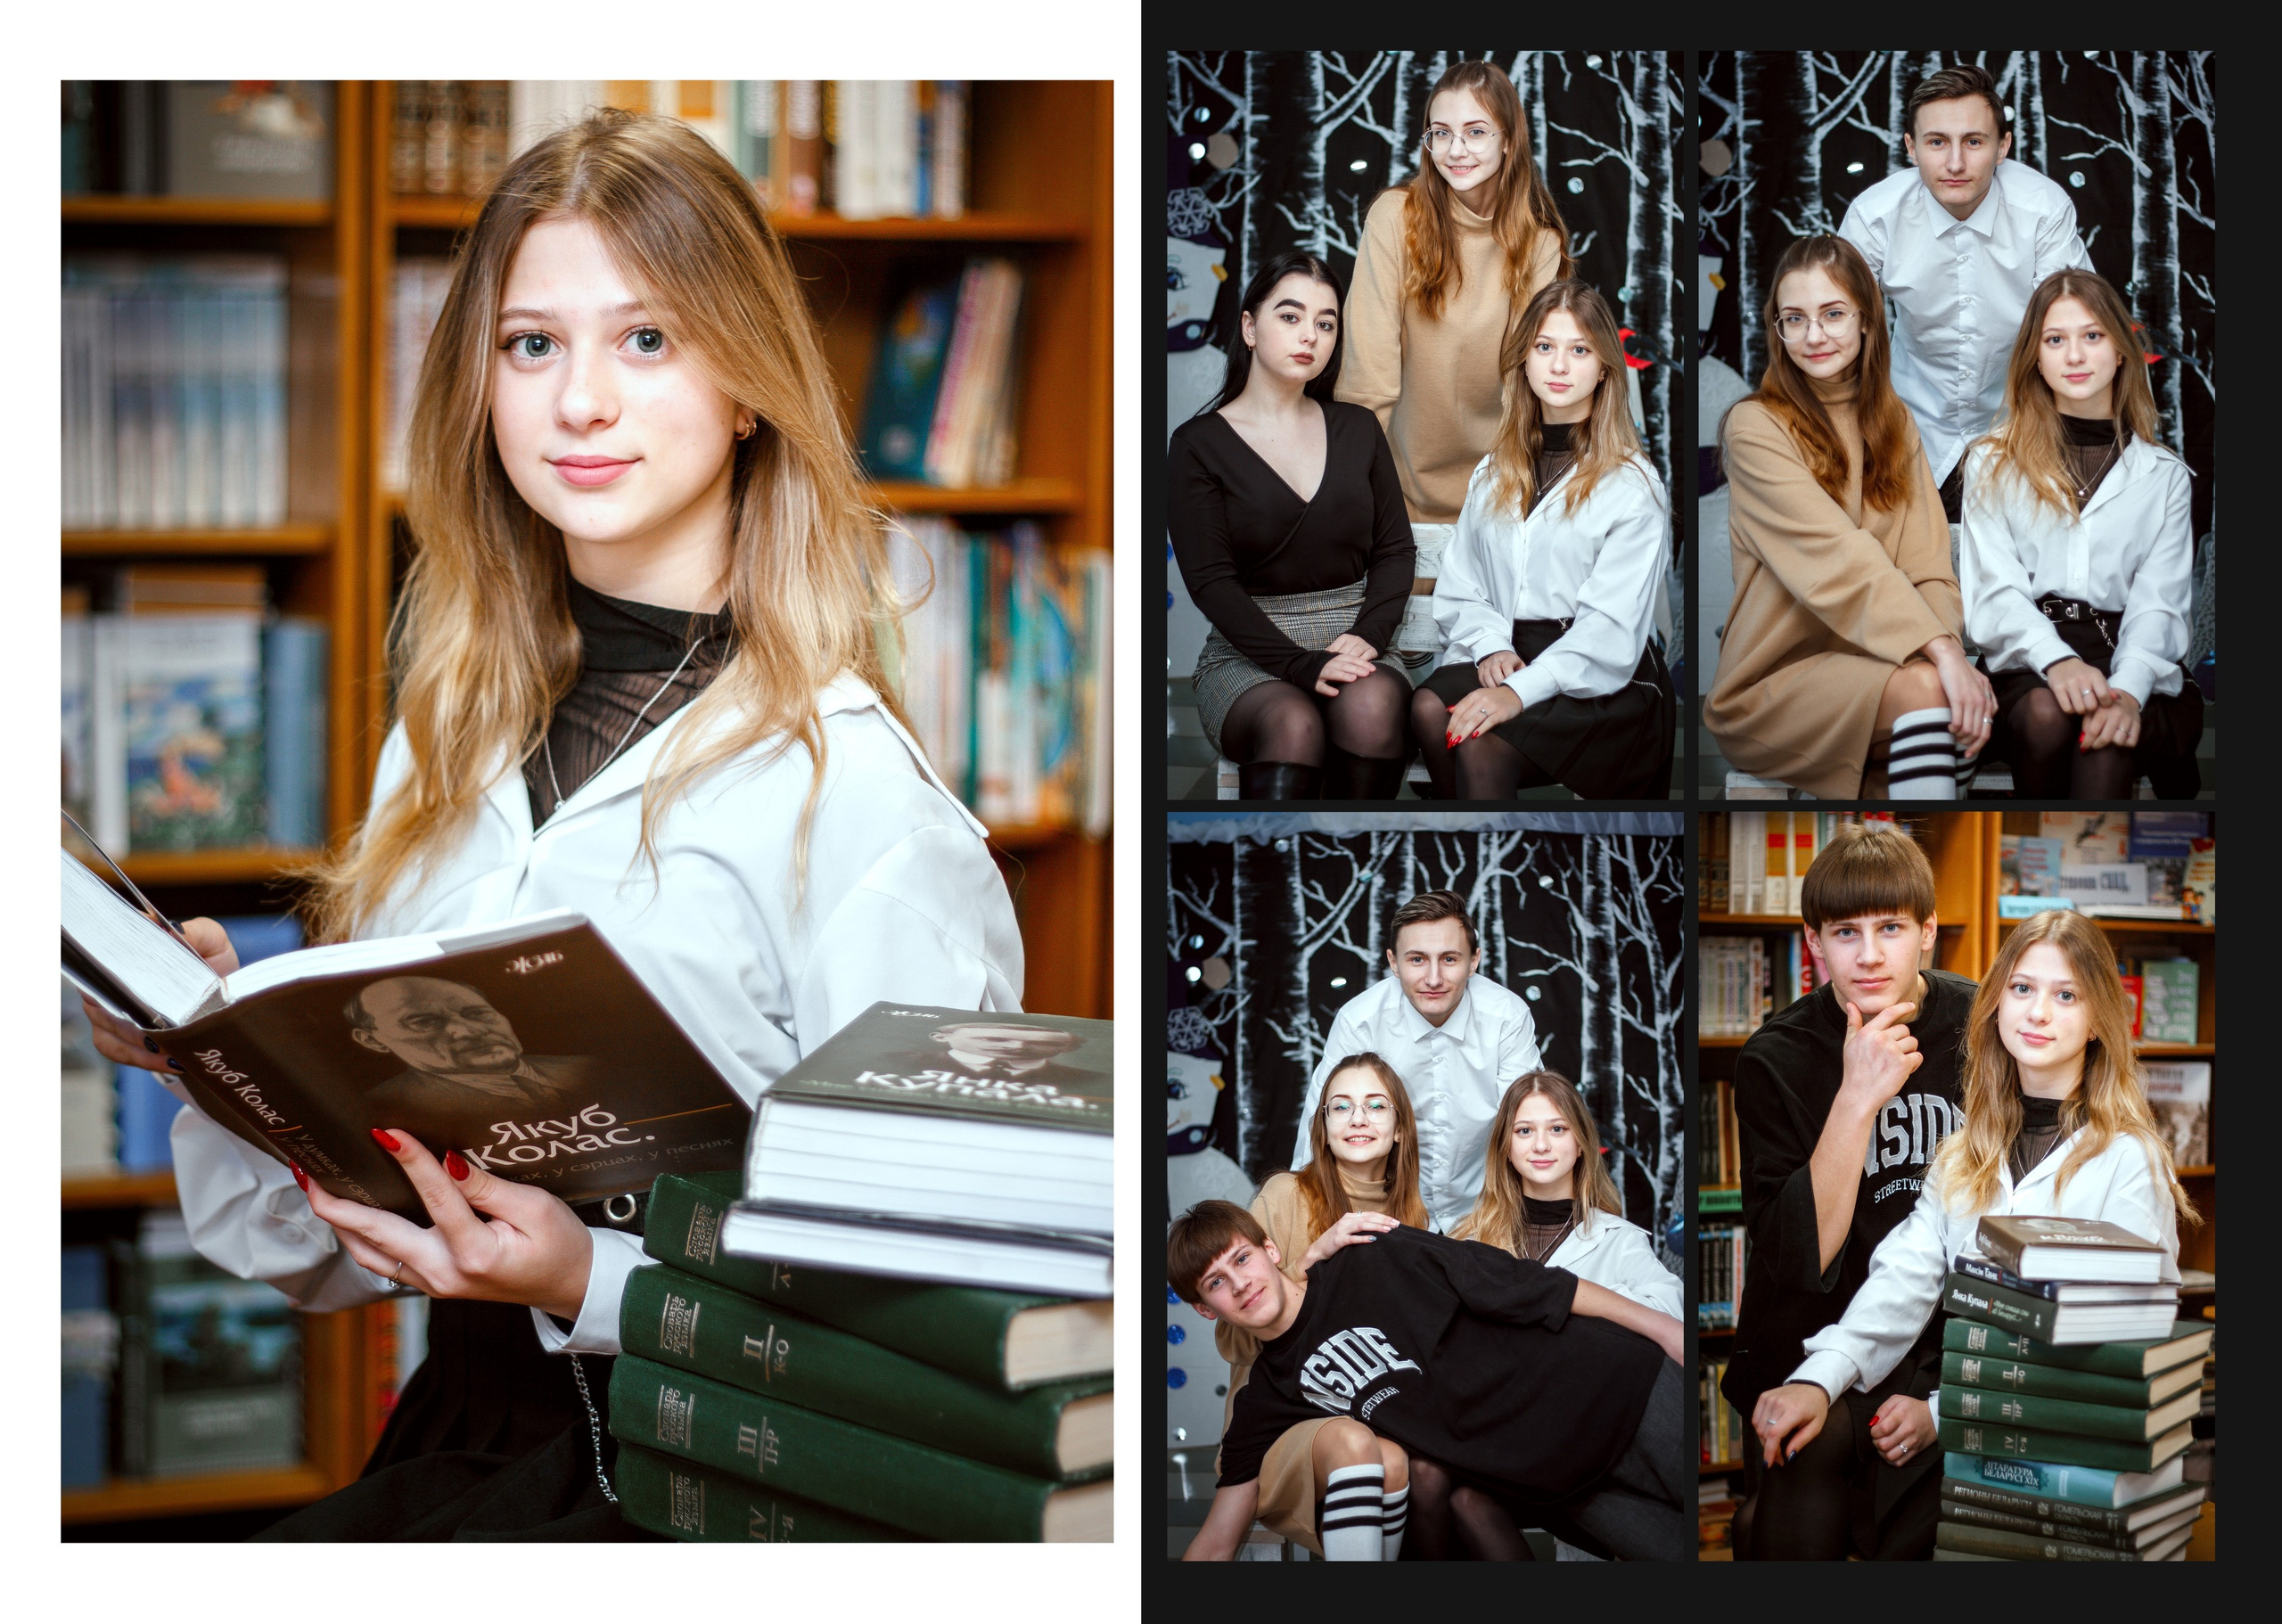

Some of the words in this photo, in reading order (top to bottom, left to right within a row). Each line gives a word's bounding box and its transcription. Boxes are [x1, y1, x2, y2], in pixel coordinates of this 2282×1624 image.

[193, 1049, 250, 1084] Якуб
[234, 1083, 285, 1126] Колас
[907, 1070, 1059, 1096] Янка
[489, 1103, 617, 1145] Якуб
[463, 1127, 656, 1171] Колас.
[666, 1137, 734, 1155] песнях
[688, 1205, 706, 1258] Словарь
[696, 1207, 712, 1262] русского
[702, 1218, 716, 1256] языка
[1984, 1267, 1999, 1282] Танк
[1952, 1289, 1966, 1302] Янка
[1967, 1292, 1989, 1308] Купала
[663, 1296, 679, 1349] Словарь
[673, 1298, 686, 1355] русского
[681, 1308, 693, 1349] языка
[660, 1388, 674, 1442] Словарь
[670, 1390, 681, 1446] русского
[677, 1401, 686, 1441] языка
[738, 1422, 758, 1457] III
[765, 1429, 780, 1465] П-Р
[1984, 1460, 2033, 1477] ЛІТАРАТУРА
[1984, 1468, 2023, 1483] БЕЛАРУСІ
[1954, 1486, 1991, 1501] РЕГИОНЫ
[1992, 1494, 2032, 1508] БЕЛАРУСИ
[2055, 1504, 2103, 1520] ГОМЕЛЬСКАЯ
